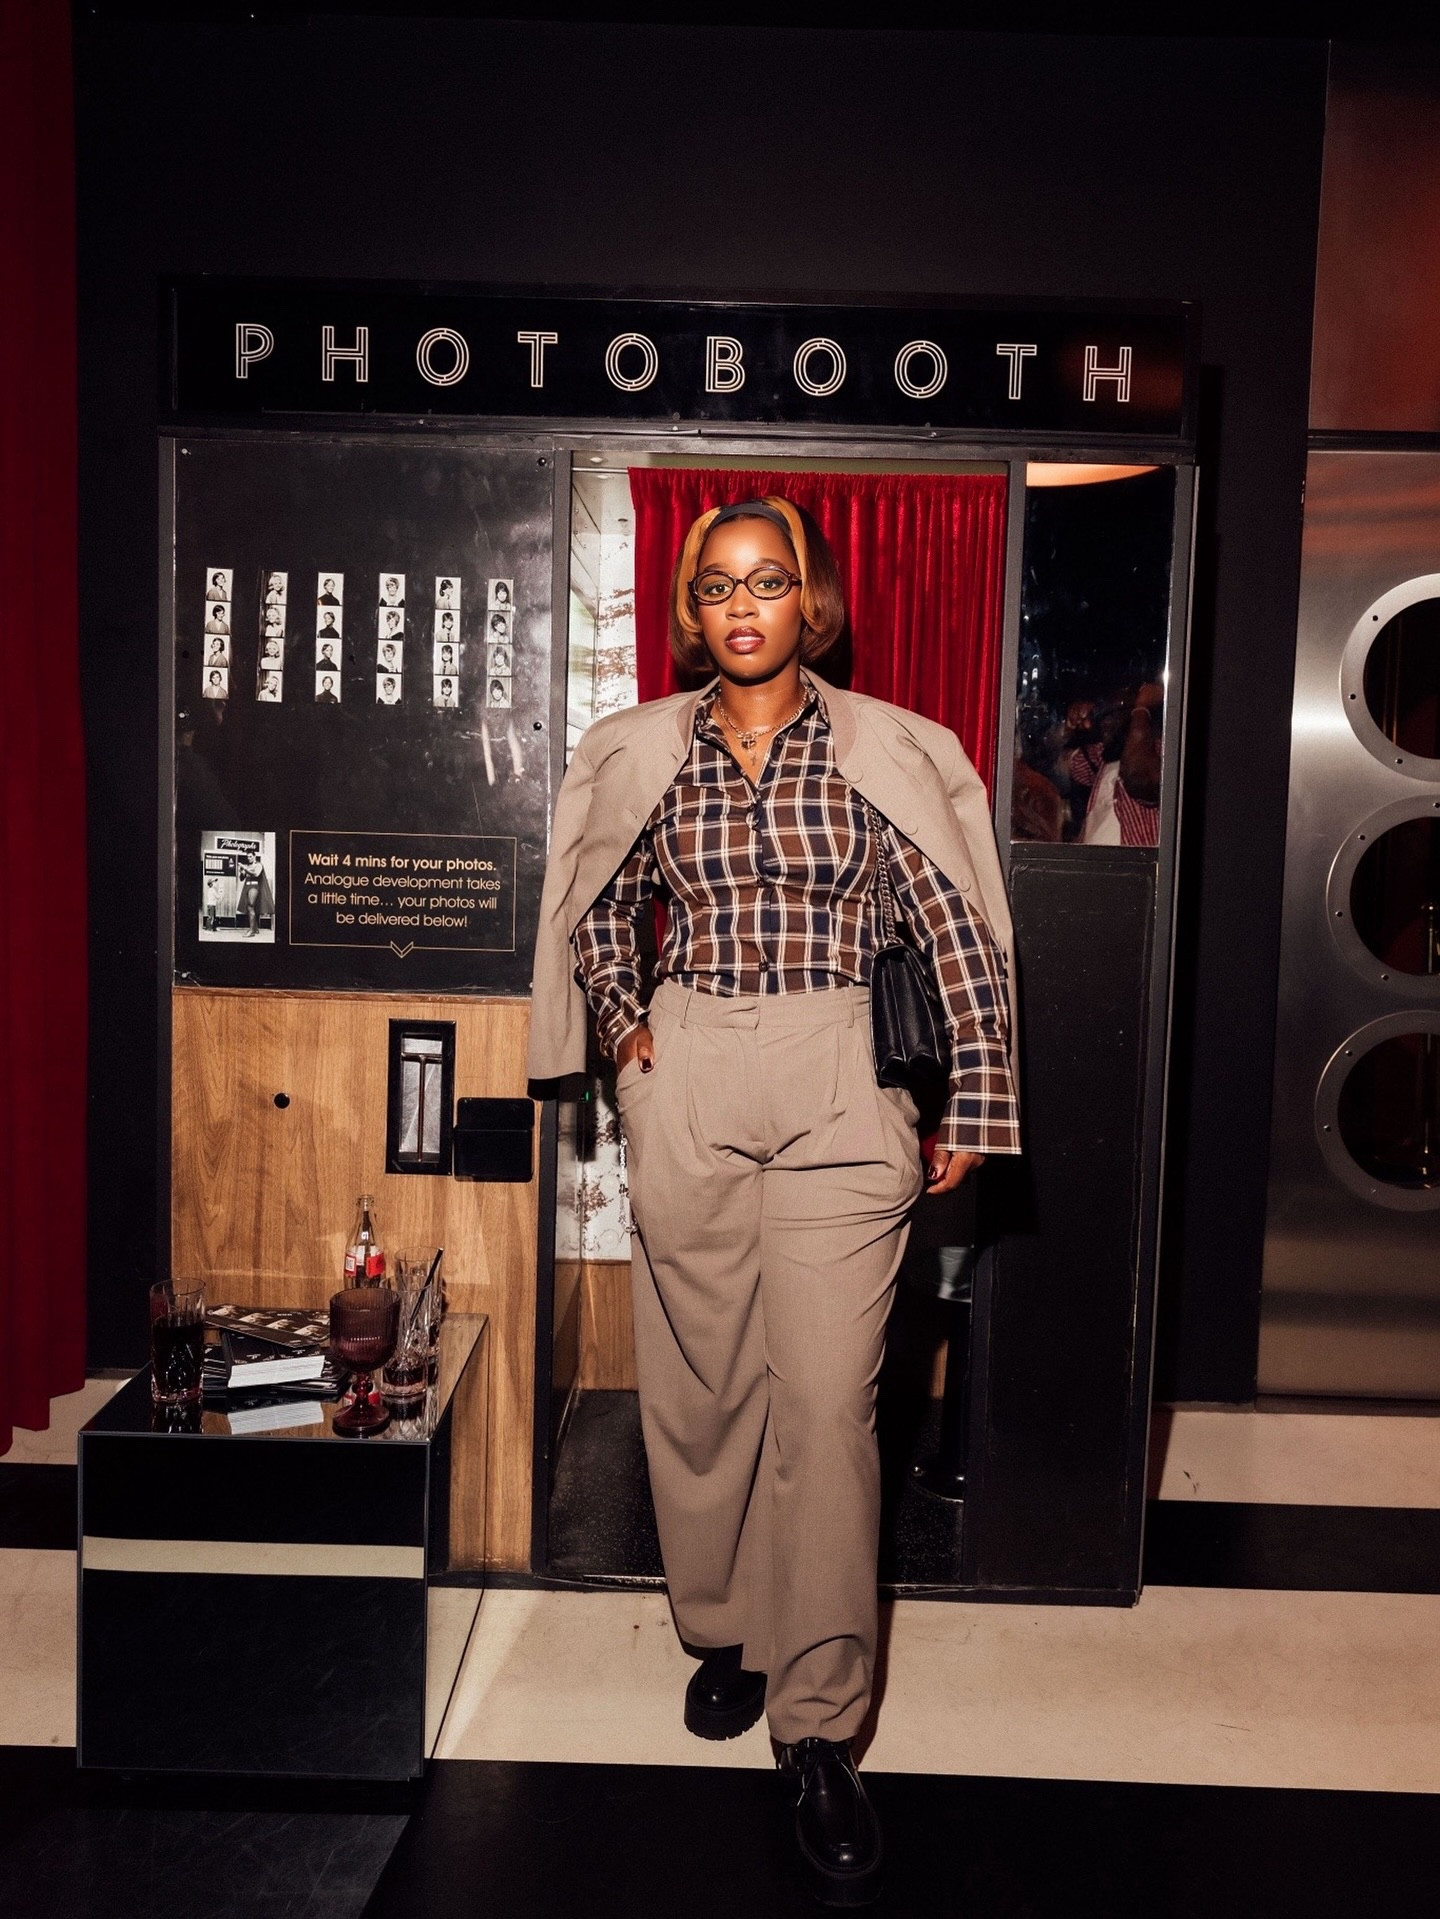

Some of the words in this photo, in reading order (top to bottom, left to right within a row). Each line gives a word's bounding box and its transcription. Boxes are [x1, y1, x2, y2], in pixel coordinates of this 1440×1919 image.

[234, 322, 1133, 404] PHOTOBOOTH
[308, 853, 339, 866] Wait
[342, 855, 351, 866] 4
[355, 855, 387, 867] mins
[391, 856, 409, 868] for
[412, 859, 443, 871] your
[447, 858, 498, 872] photos.
[305, 873, 369, 888] Analogue
[373, 875, 463, 890] development
[467, 876, 500, 890] takes
[308, 894, 317, 903] a
[322, 892, 346, 904] little
[398, 897, 426, 908] your
[430, 896, 475, 909] photos
[478, 897, 497, 909] will
[337, 912, 354, 924] be
[358, 913, 419, 926] delivered
[424, 915, 467, 927] below!
